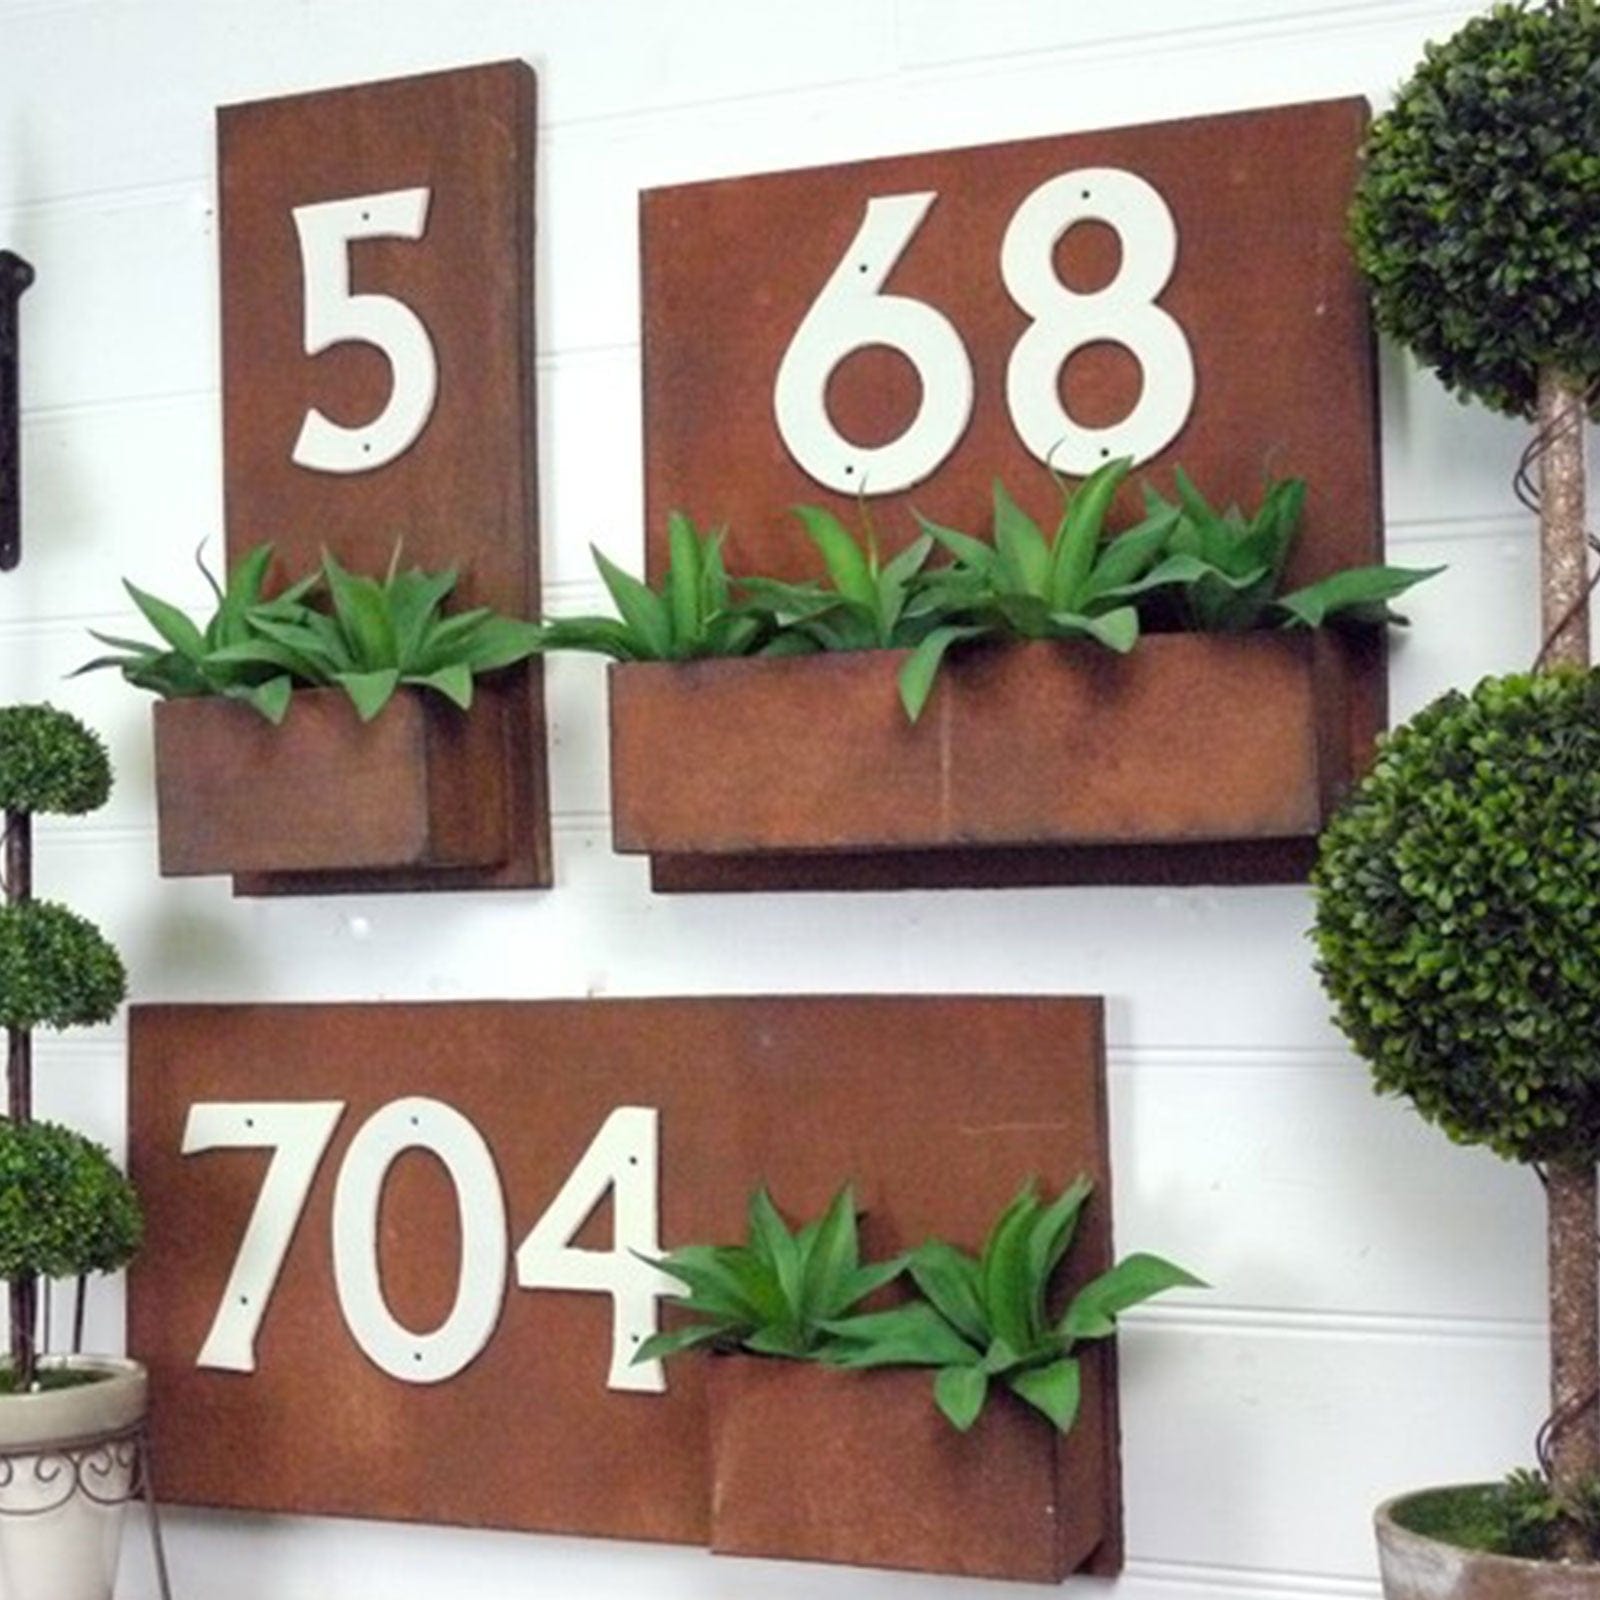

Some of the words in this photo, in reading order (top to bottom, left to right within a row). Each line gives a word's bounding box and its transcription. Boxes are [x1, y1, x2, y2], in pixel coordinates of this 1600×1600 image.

[292, 187, 437, 473] 5
[774, 167, 1195, 495] 68
[181, 1096, 692, 1392] 704
